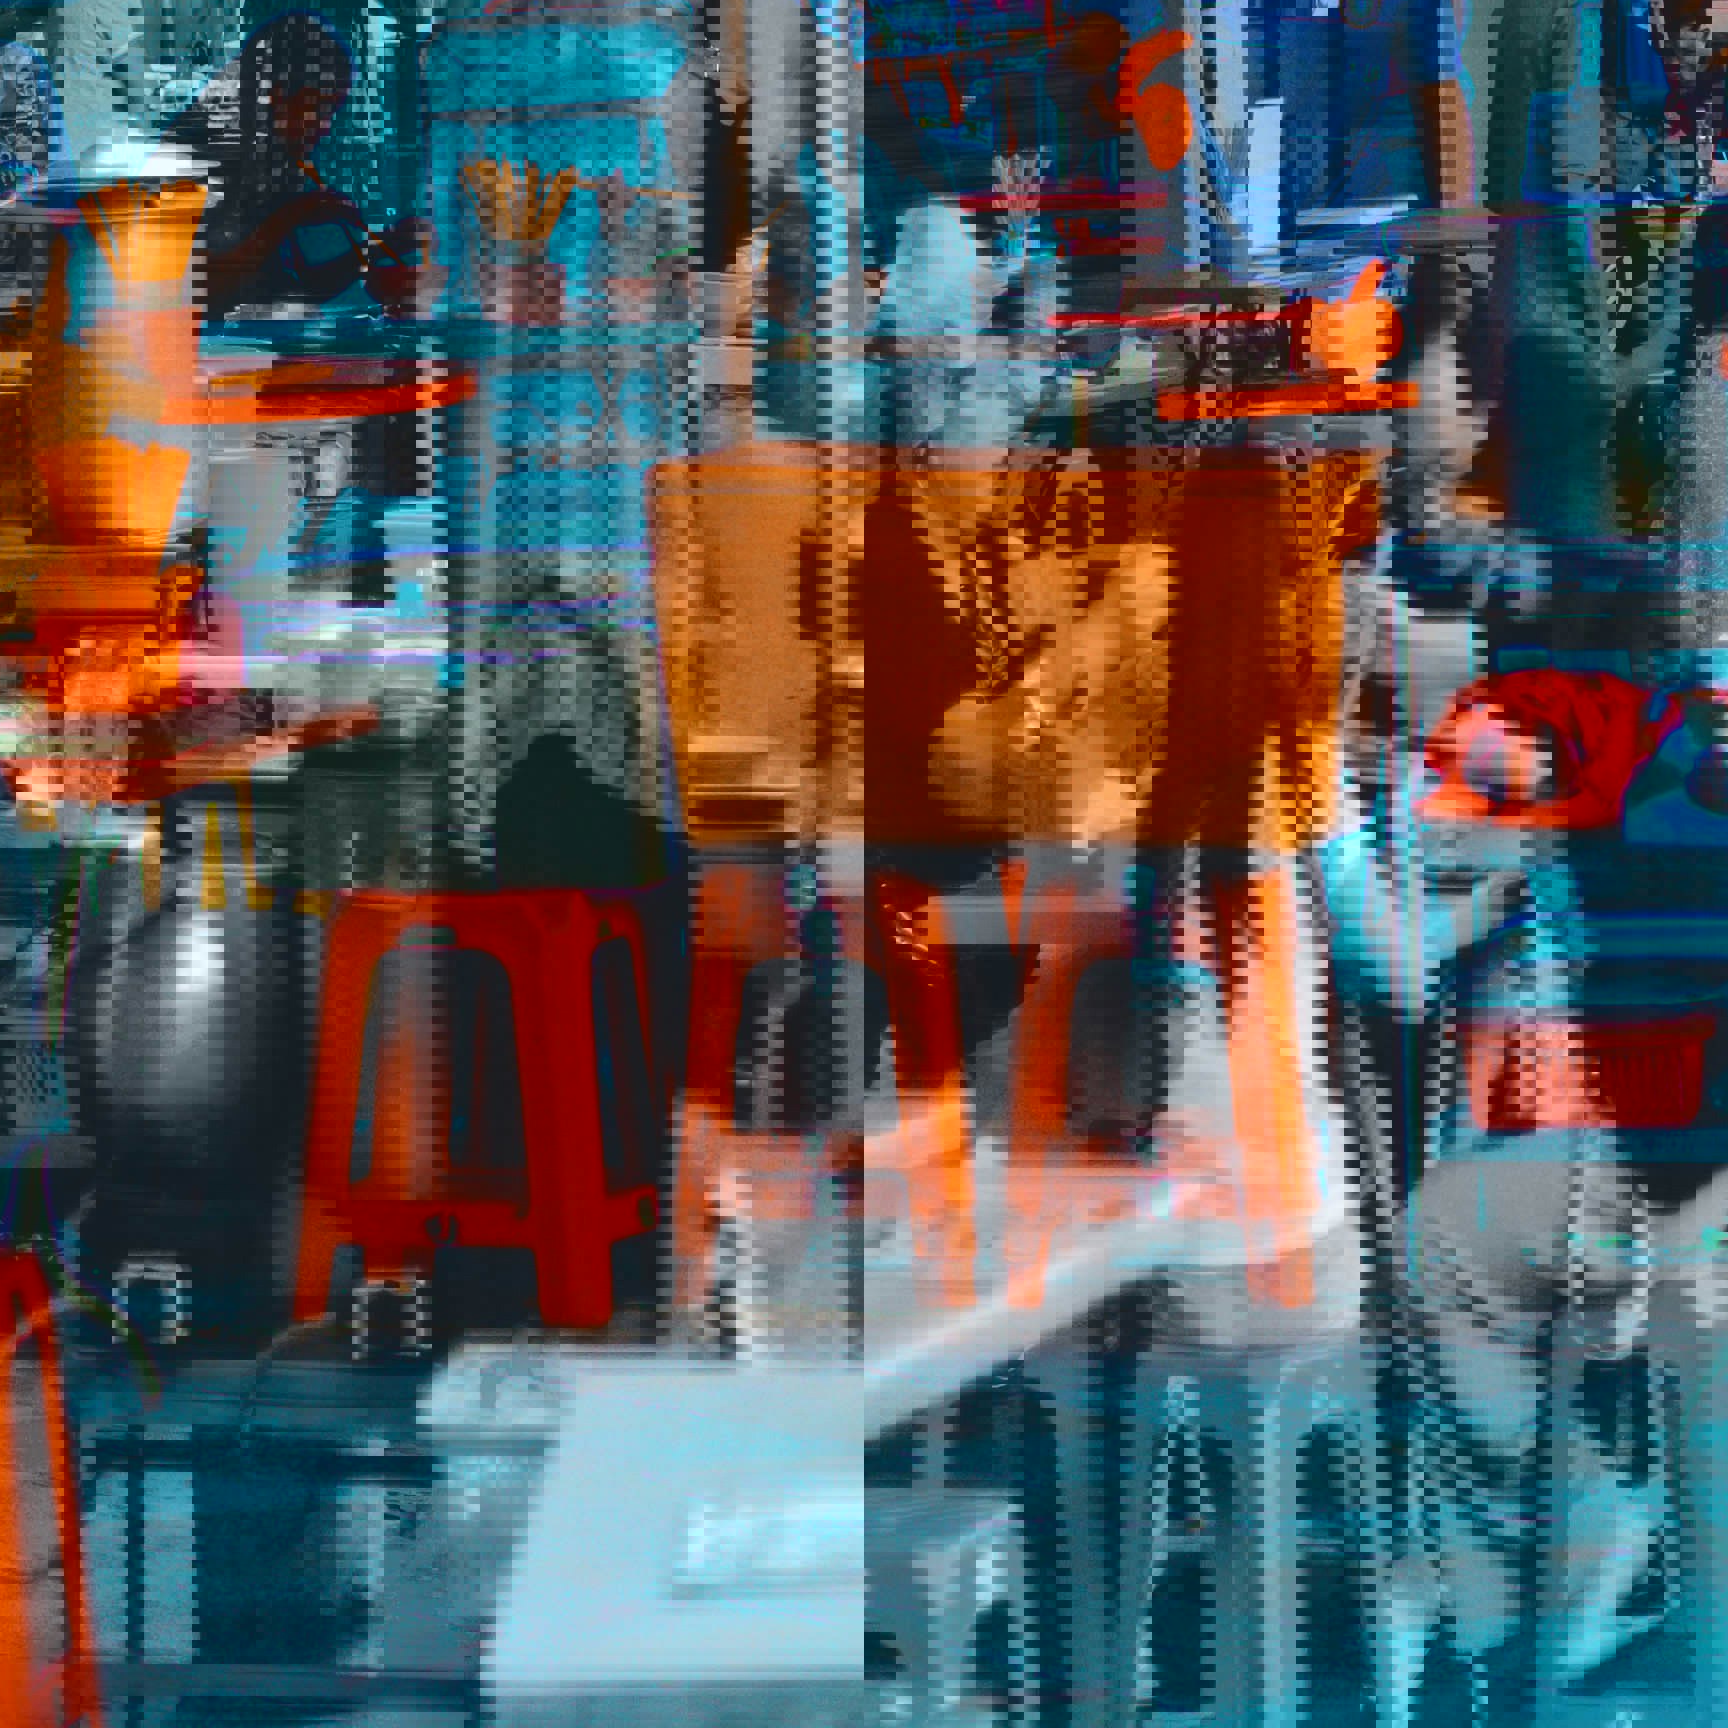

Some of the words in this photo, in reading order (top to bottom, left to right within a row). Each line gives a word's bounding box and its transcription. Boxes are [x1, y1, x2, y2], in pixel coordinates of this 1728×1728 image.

[122, 1, 205, 18] COLOUR
[109, 27, 152, 44] HOT
[50, 54, 145, 78] HOURS
[72, 112, 159, 129] AIRPORT
